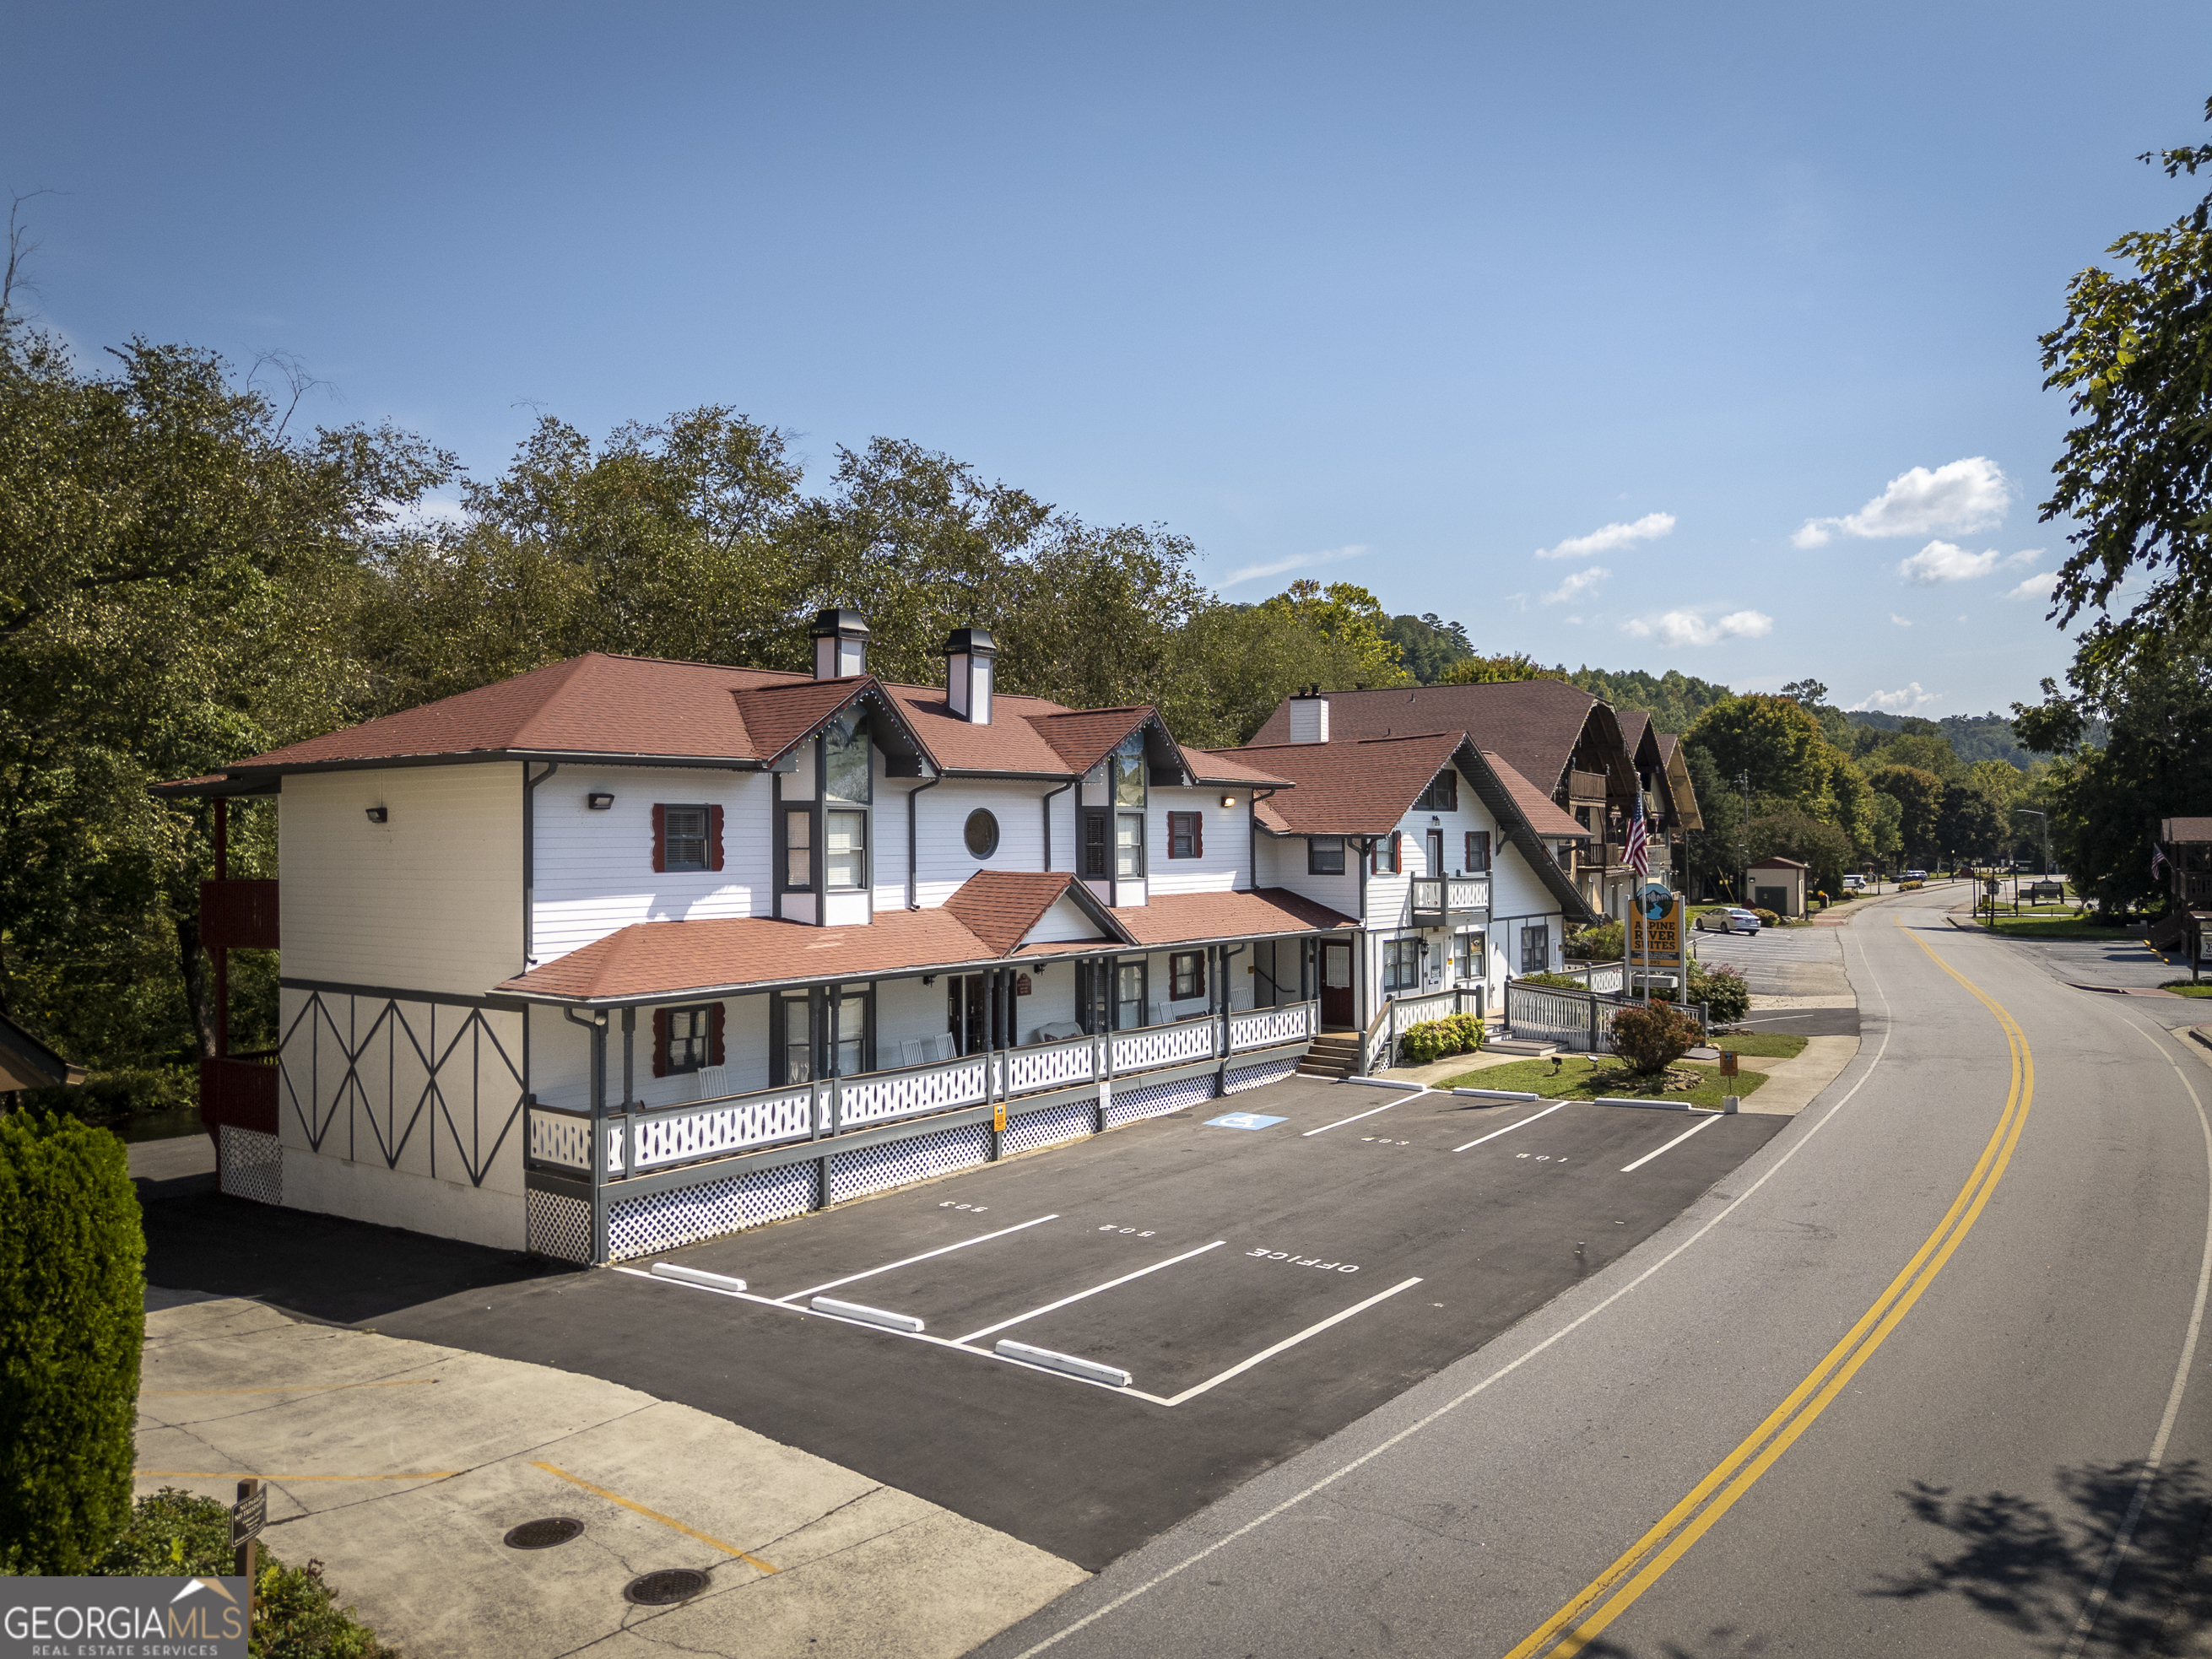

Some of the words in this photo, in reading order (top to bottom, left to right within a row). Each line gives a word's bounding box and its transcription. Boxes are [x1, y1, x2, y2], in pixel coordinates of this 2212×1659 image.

[1634, 921, 1675, 930] APINE
[1634, 930, 1675, 941] RVER
[938, 1201, 989, 1213] 503
[1098, 1224, 1156, 1238] 502
[1245, 1247, 1360, 1274] OFFICE
[240, 1503, 248, 1512] NO
[235, 1512, 243, 1521] NO
